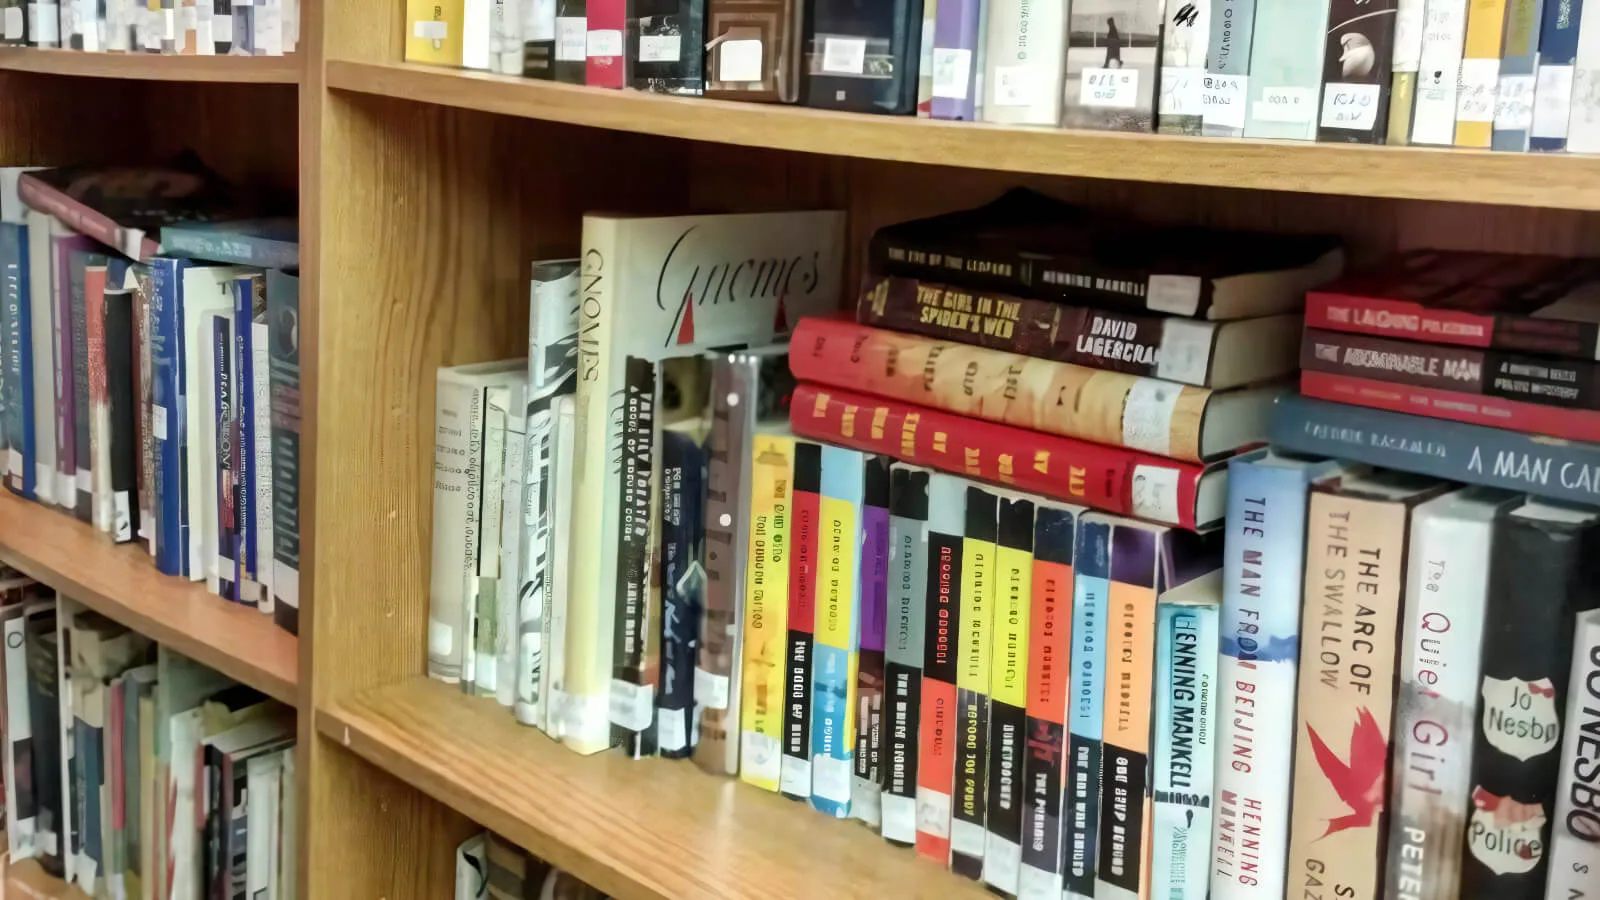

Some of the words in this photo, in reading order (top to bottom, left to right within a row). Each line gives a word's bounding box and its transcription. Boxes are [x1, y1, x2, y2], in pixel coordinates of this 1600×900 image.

[915, 286, 943, 307] THE
[943, 290, 975, 315] GIRL
[976, 295, 994, 316] IN
[995, 299, 1023, 322] THE
[1091, 316, 1138, 341] DAVID
[1466, 445, 1483, 475] A
[1492, 450, 1553, 485] MAN
[1243, 497, 1268, 539] THE
[1325, 510, 1352, 559] THE
[1239, 548, 1264, 598] MAN
[1355, 547, 1382, 595] THE
[1236, 608, 1261, 669] FROM
[1318, 568, 1346, 691] SWALLOW
[1351, 603, 1378, 656] ARC
[1173, 614, 1199, 700] HENNING
[1348, 663, 1374, 697] OF
[1508, 685, 1533, 711] Jo
[1169, 705, 1195, 789] MANKELL
[1230, 680, 1257, 774] BEIJING
[1407, 719, 1450, 796] Girl
[1215, 790, 1238, 878] MANKELL
[1238, 797, 1263, 887] HENNING
[1471, 820, 1543, 862] Police
